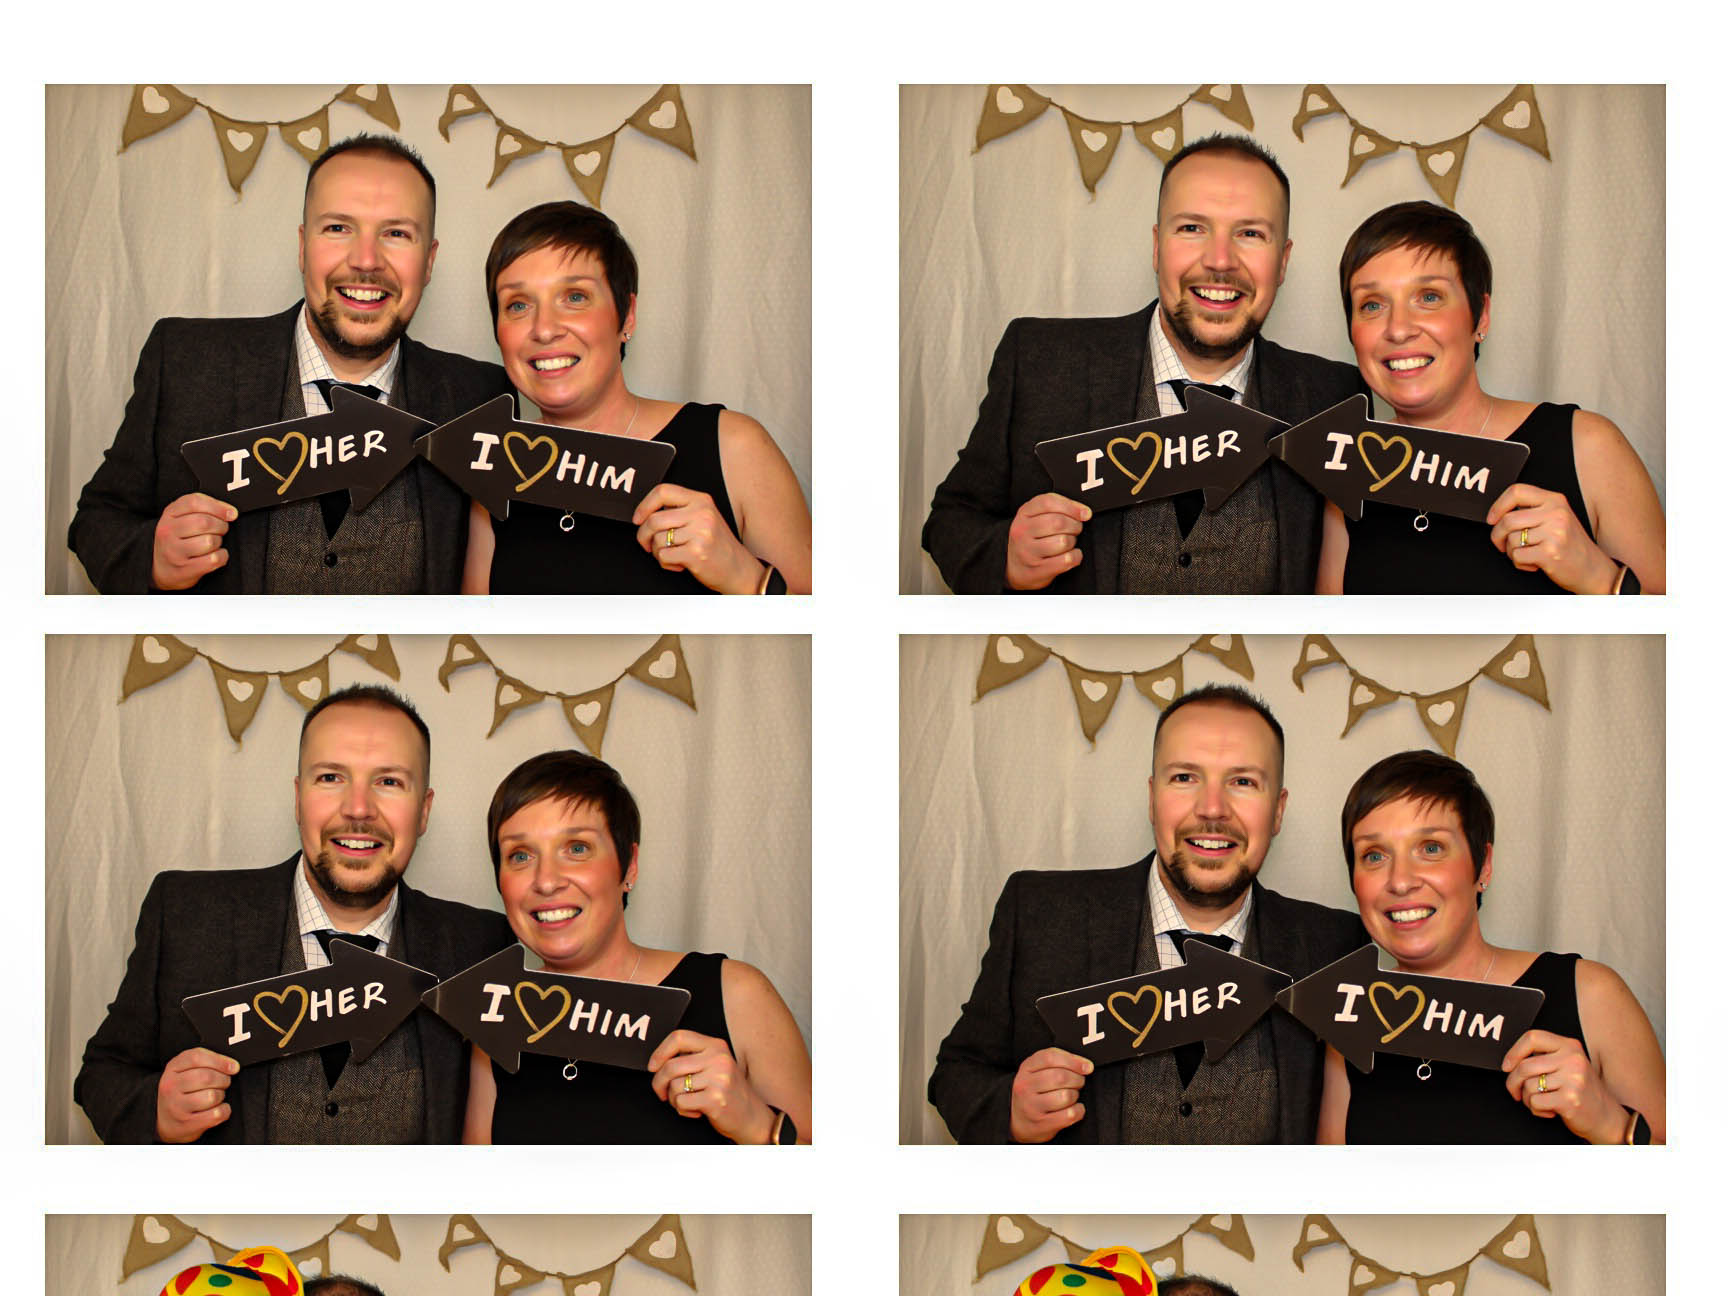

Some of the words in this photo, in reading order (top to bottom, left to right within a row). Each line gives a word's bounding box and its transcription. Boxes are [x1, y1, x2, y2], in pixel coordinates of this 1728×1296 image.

[222, 448, 251, 492] I
[309, 429, 388, 469] HER
[470, 432, 500, 471] I
[556, 450, 636, 494] HIM
[1076, 448, 1105, 492] I
[1163, 429, 1242, 469] HER
[1324, 432, 1354, 471] I
[1410, 450, 1490, 494] HIM
[223, 1002, 251, 1046] I
[310, 982, 388, 1022] HER
[480, 983, 511, 1022] I
[568, 998, 651, 1041] HIM
[1077, 1002, 1105, 1046] I
[1164, 982, 1242, 1022] HER
[1334, 983, 1365, 1022] I
[1422, 998, 1505, 1041] HIM
